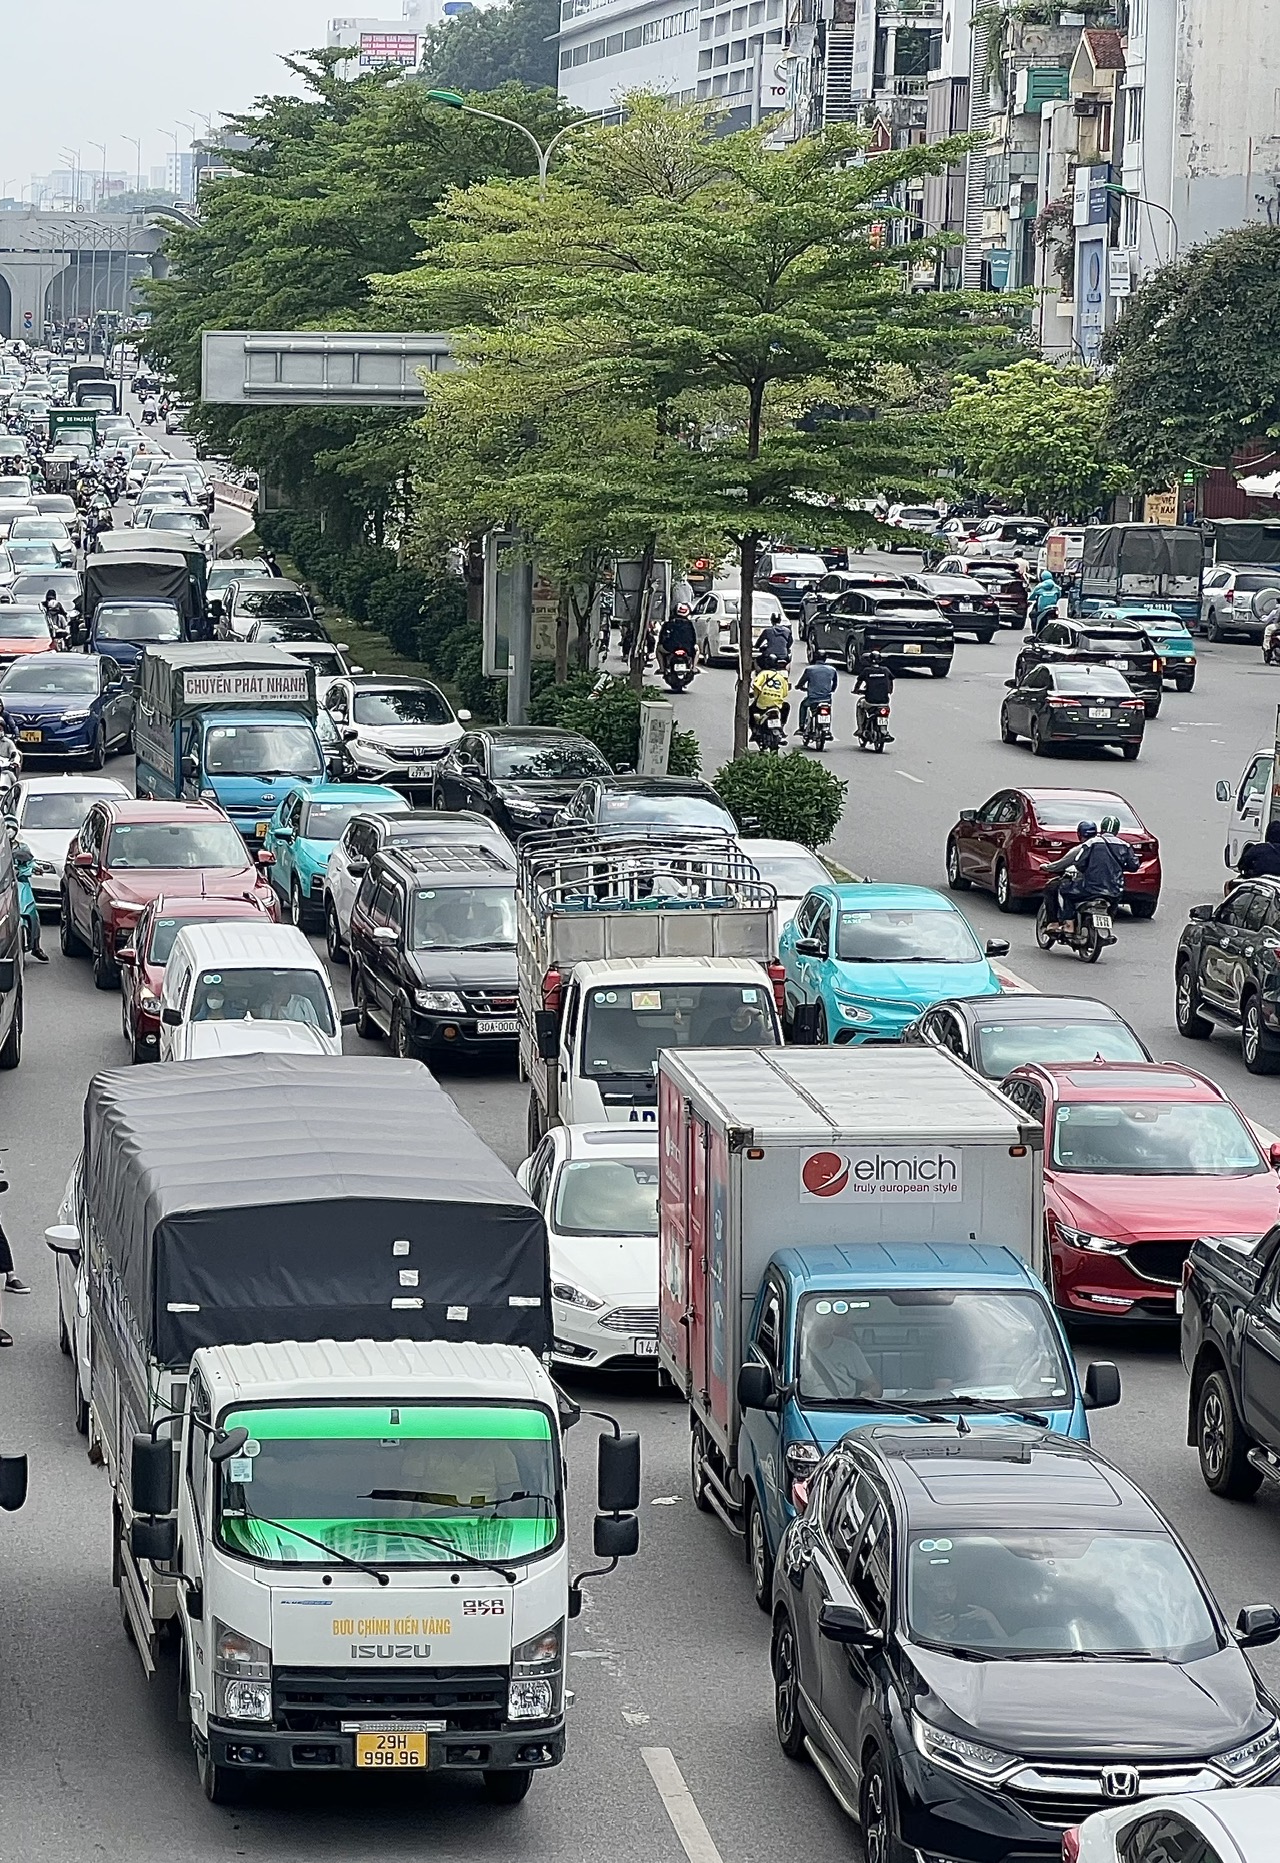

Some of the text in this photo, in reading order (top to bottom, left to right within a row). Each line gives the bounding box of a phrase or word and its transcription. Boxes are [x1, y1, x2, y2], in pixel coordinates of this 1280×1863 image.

[770, 87, 786, 95] TO
[235, 675, 263, 693] PHÁT
[267, 677, 306, 693] NHANH
[479, 1022, 521, 1032] 30A-000.0
[854, 1154, 956, 1181] elmich
[853, 1183, 958, 1194] truly european style
[357, 1616, 391, 1636] CHÍNH
[422, 1616, 451, 1635] VÀNG
[351, 1644, 432, 1659] ISUZU
[377, 1735, 407, 1749] 29H
[364, 1751, 420, 1765] 998.96
